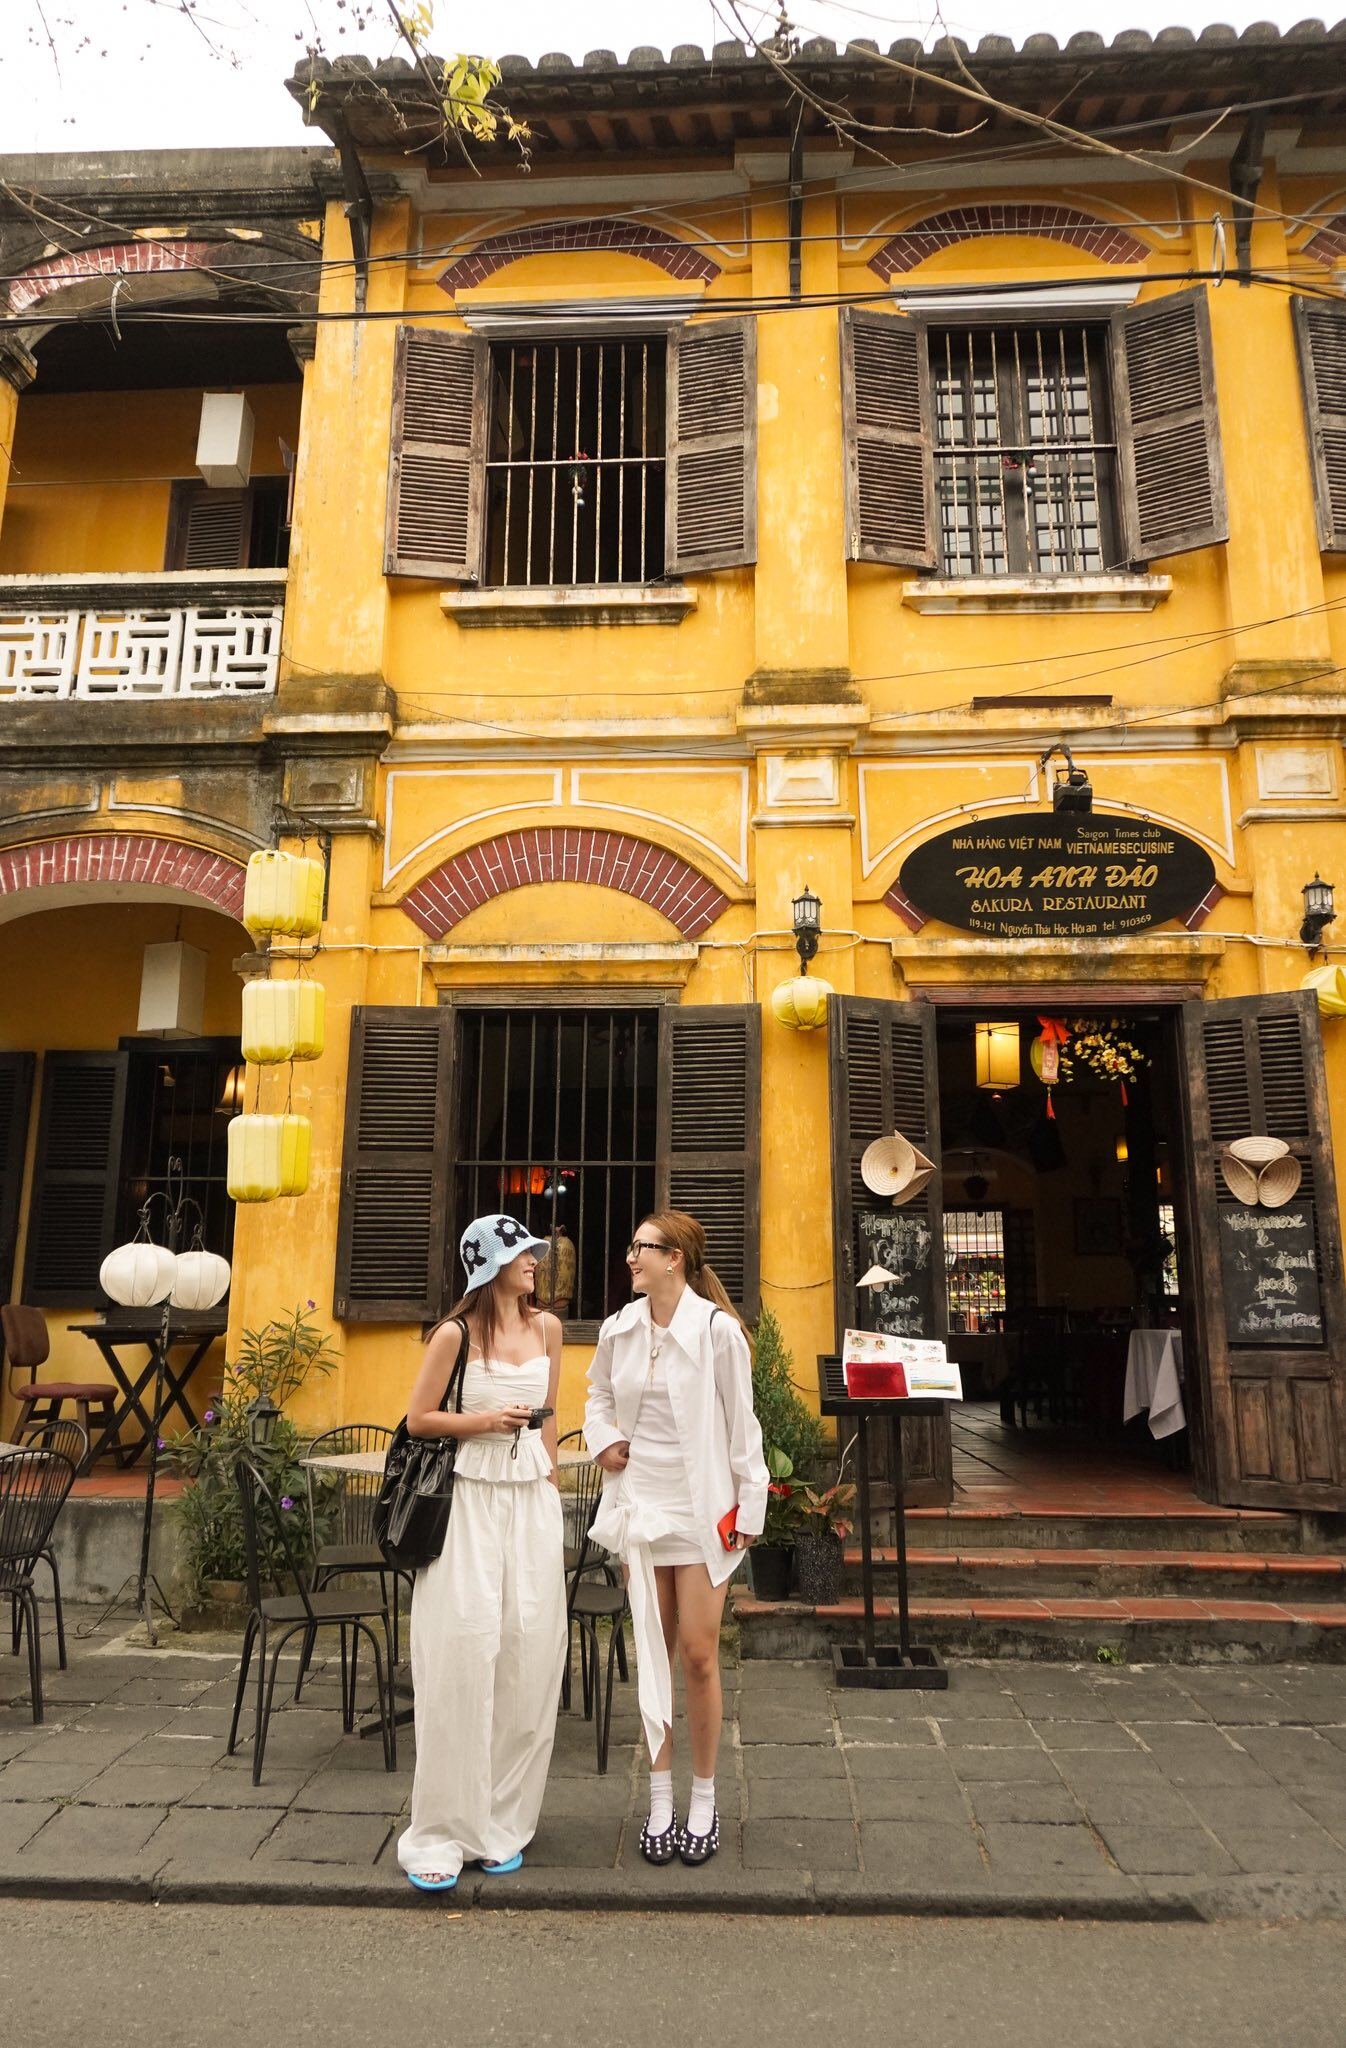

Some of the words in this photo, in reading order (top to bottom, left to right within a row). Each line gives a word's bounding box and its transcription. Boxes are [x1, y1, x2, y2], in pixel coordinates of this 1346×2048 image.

[1077, 827, 1109, 841] Saigon
[1114, 828, 1140, 838] Times
[1143, 828, 1161, 838] club
[1008, 836, 1035, 850] VIỆT
[1038, 838, 1062, 849] NAM
[955, 866, 1023, 889] HOA
[1029, 866, 1098, 888] ANH
[971, 898, 1033, 913] SAKURA
[1043, 895, 1147, 911] RESTAURANT
[969, 918, 995, 931] 119-121
[1120, 914, 1152, 928] 910369
